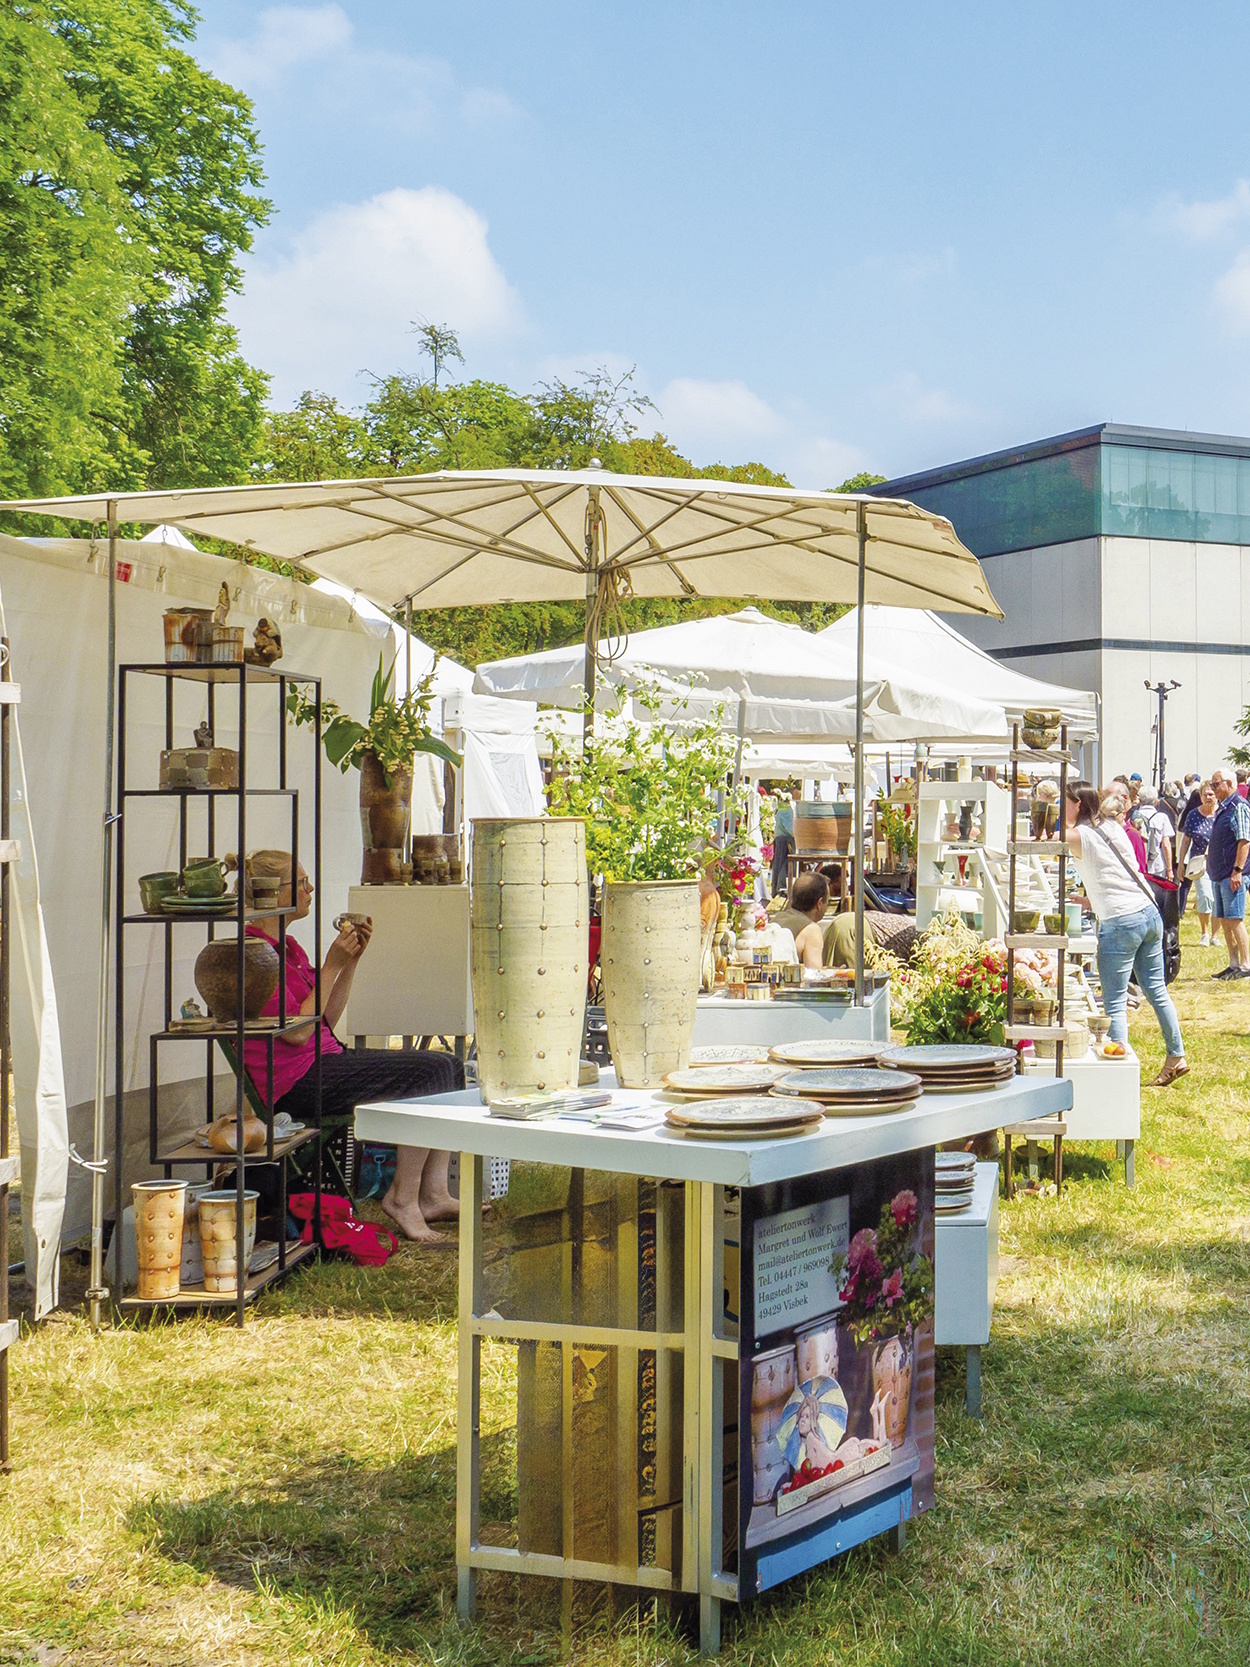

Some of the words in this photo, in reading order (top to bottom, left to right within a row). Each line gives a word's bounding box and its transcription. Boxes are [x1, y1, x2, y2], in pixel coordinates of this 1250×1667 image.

[758, 1213, 816, 1239] ateliertonwerk
[758, 1238, 790, 1256] Margret
[791, 1232, 806, 1245] und
[808, 1225, 825, 1240] Wolf
[826, 1221, 848, 1235] Ewert
[757, 1275, 772, 1288] Tel.
[774, 1266, 797, 1283] 04447
[758, 1284, 793, 1304] Hagstedt
[795, 1279, 809, 1292] 28a
[758, 1303, 782, 1320] 49429
[783, 1294, 809, 1311] Visbek
